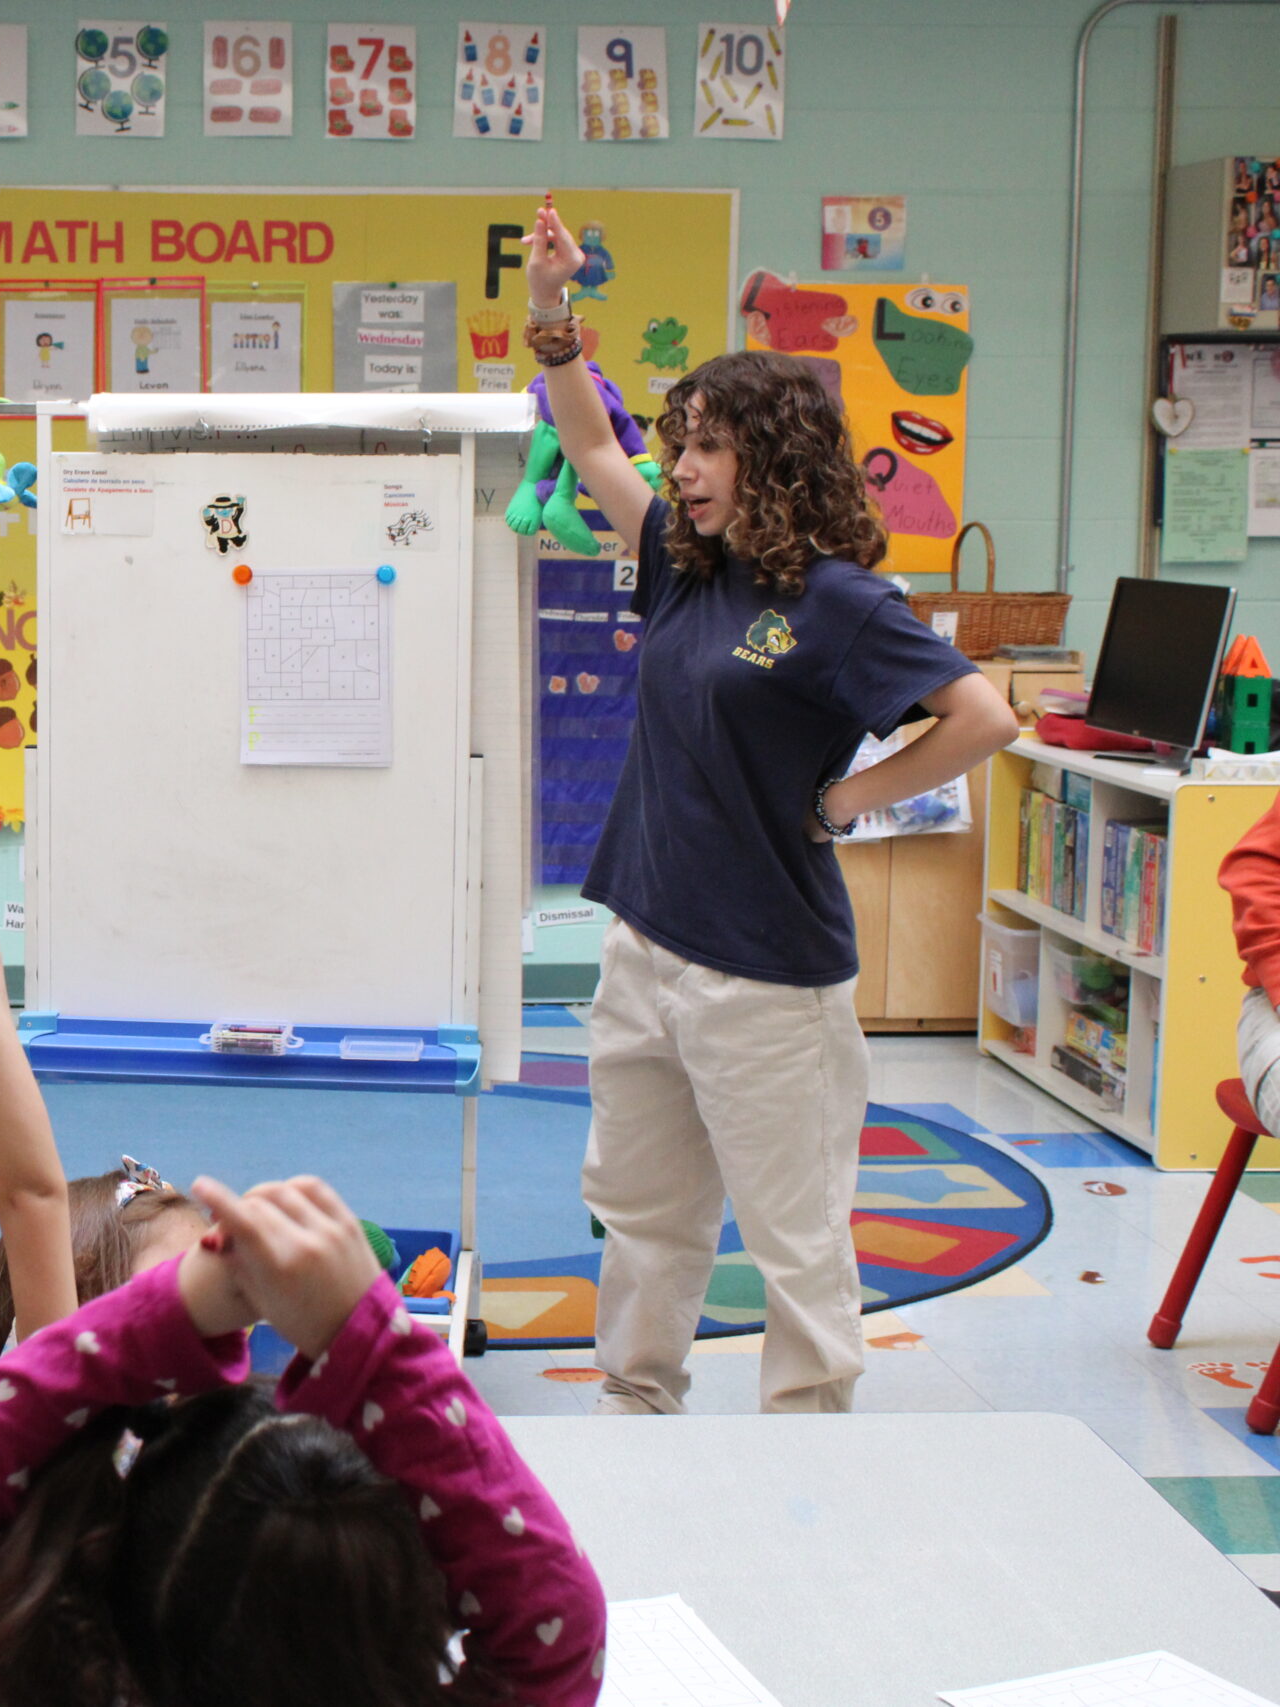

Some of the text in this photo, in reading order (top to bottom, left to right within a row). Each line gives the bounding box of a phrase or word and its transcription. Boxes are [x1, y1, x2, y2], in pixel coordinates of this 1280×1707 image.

[108, 36, 137, 78] 5
[231, 35, 262, 77] 6
[356, 38, 385, 80] 7
[483, 35, 514, 76] 8
[606, 37, 634, 79] 9
[718, 34, 765, 76] 10
[150, 219, 335, 265] BOARD
[485, 224, 524, 299] F
[363, 294, 419, 305] Yesterday
[379, 310, 403, 319] was:
[358, 333, 424, 346] Wednesday
[777, 327, 833, 350] Ears
[369, 363, 403, 375] Today
[476, 365, 514, 375] French
[897, 356, 955, 394] Eyes
[481, 379, 508, 389] Fries
[91, 468, 108, 476] Easel
[863, 447, 934, 493] Quiet
[891, 504, 957, 534] Mouths
[619, 565, 634, 586] 2
[731, 646, 775, 669] BEARS
[540, 907, 594, 923] Dismissal
